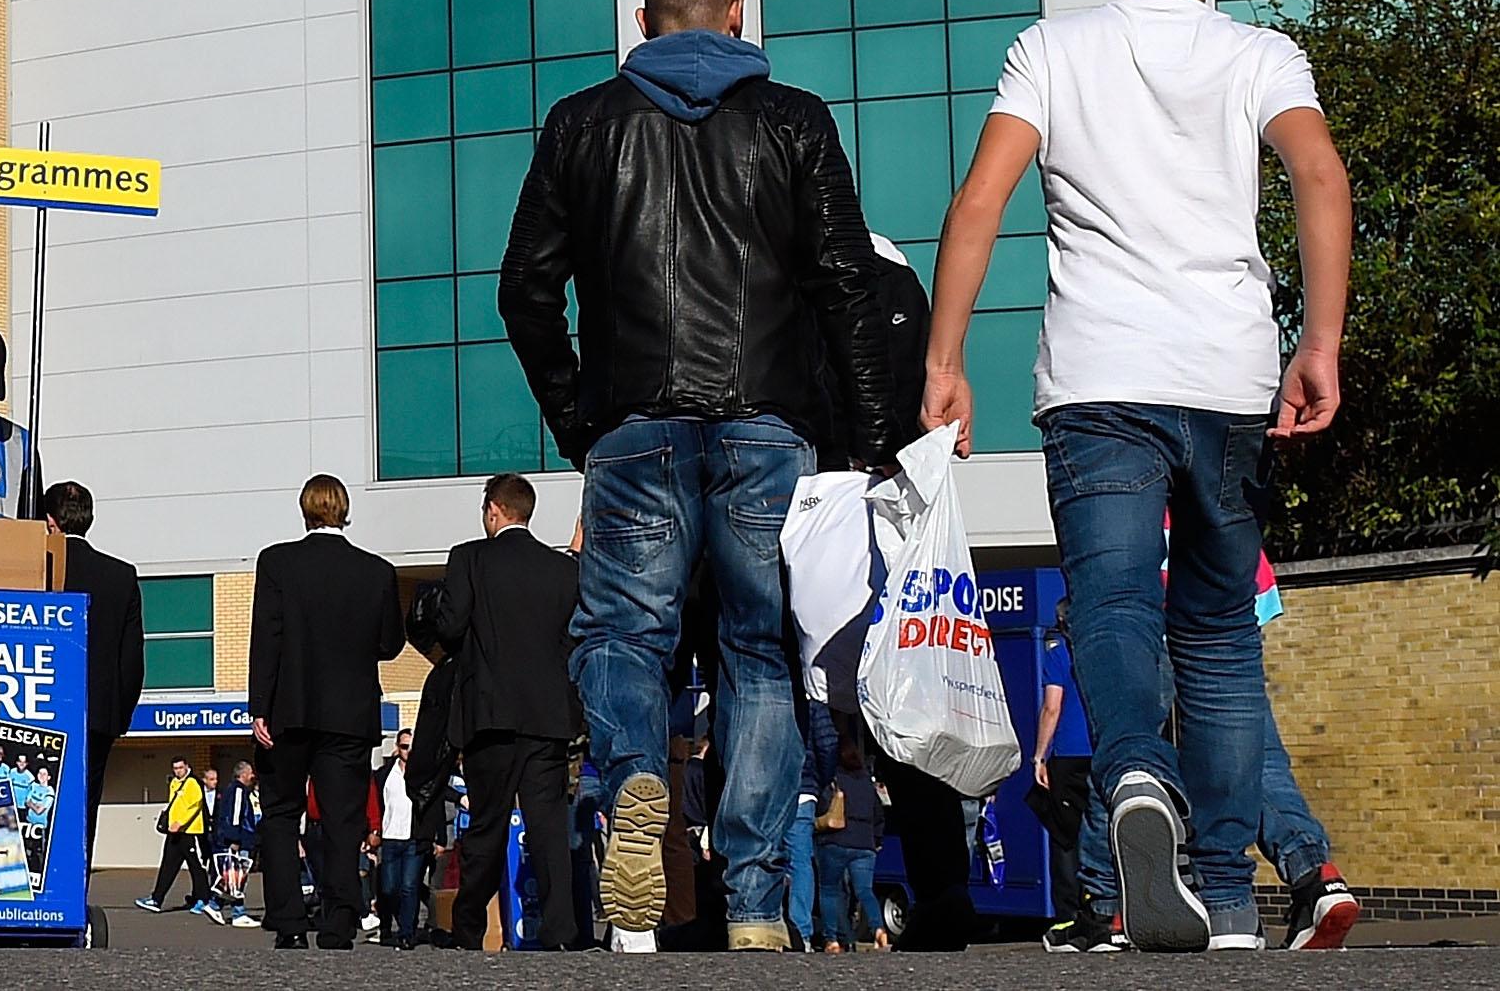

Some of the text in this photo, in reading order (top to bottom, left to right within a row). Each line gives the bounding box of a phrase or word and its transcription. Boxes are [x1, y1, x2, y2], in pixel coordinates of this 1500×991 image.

[979, 586, 1023, 612] DISE
[43, 605, 73, 626] FC
[898, 615, 992, 658] DIRECT
[155, 710, 198, 730] Upper
[200, 709, 227, 725] Tier
[43, 735, 62, 750] FC
